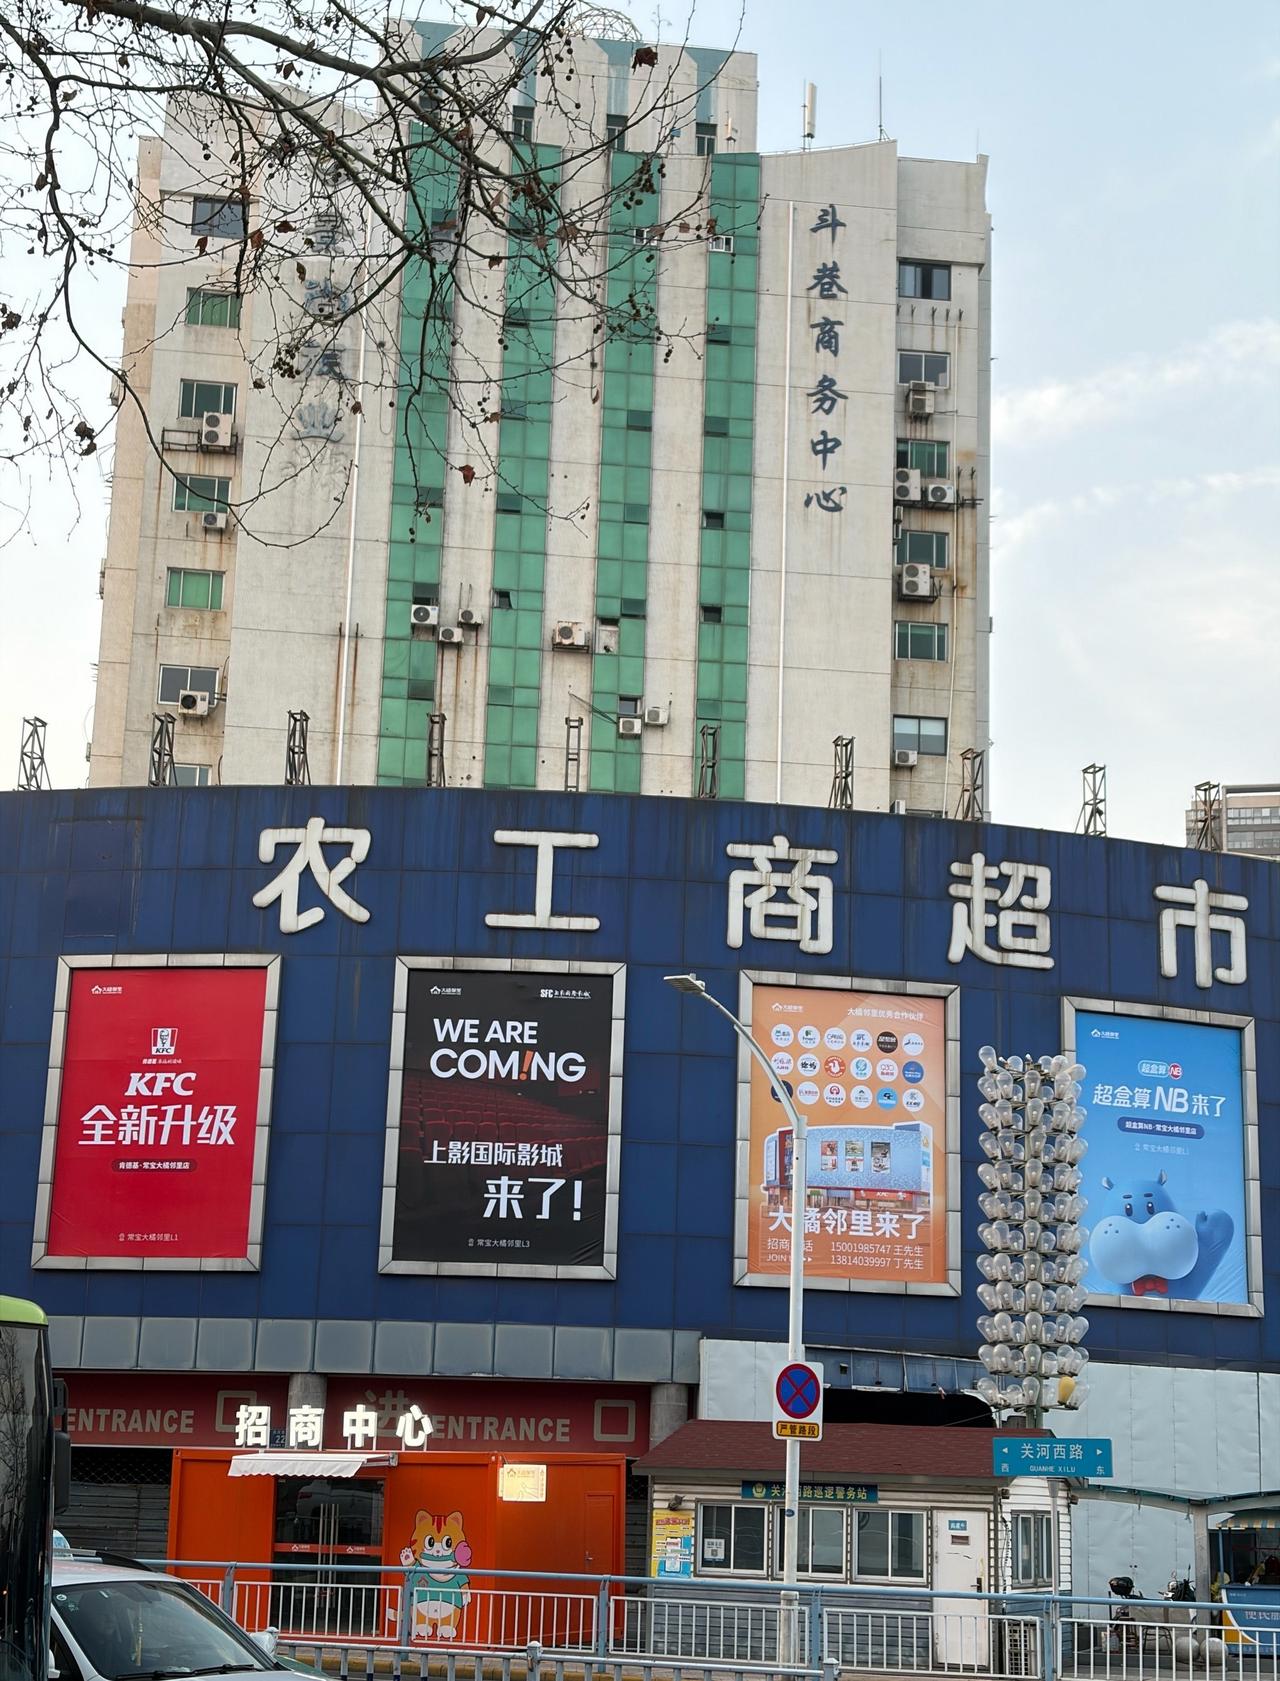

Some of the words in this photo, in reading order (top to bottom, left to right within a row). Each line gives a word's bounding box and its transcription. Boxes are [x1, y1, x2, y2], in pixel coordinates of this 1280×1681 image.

[804, 203, 848, 503] 斗巷商务中心
[251, 815, 1250, 989] 农工商超市
[433, 1018, 480, 1043] WE
[484, 1020, 538, 1044] ARE
[1170, 1066, 1183, 1076] NB
[124, 1072, 197, 1097] KFC
[78, 1104, 238, 1146] 全新升级
[424, 1140, 564, 1168] 上影国际影城
[482, 1175, 583, 1222] 来了!
[767, 1237, 814, 1252] 招商话
[830, 1241, 891, 1255] 15001985747
[893, 1245, 924, 1258] 王先生
[766, 1252, 787, 1263] JOIN
[830, 1254, 891, 1268] 13814039997
[894, 1258, 924, 1270] 丁先生
[234, 1404, 434, 1447] 招商中心
[430, 1415, 570, 1442] ENTRANCE
[779, 1423, 816, 1436] 严管路段
[1021, 1443, 1084, 1460] 关河西路
[1001, 1463, 1010, 1473] 西
[1029, 1465, 1055, 1473] GUANHE
[1096, 1466, 1105, 1475] 东
